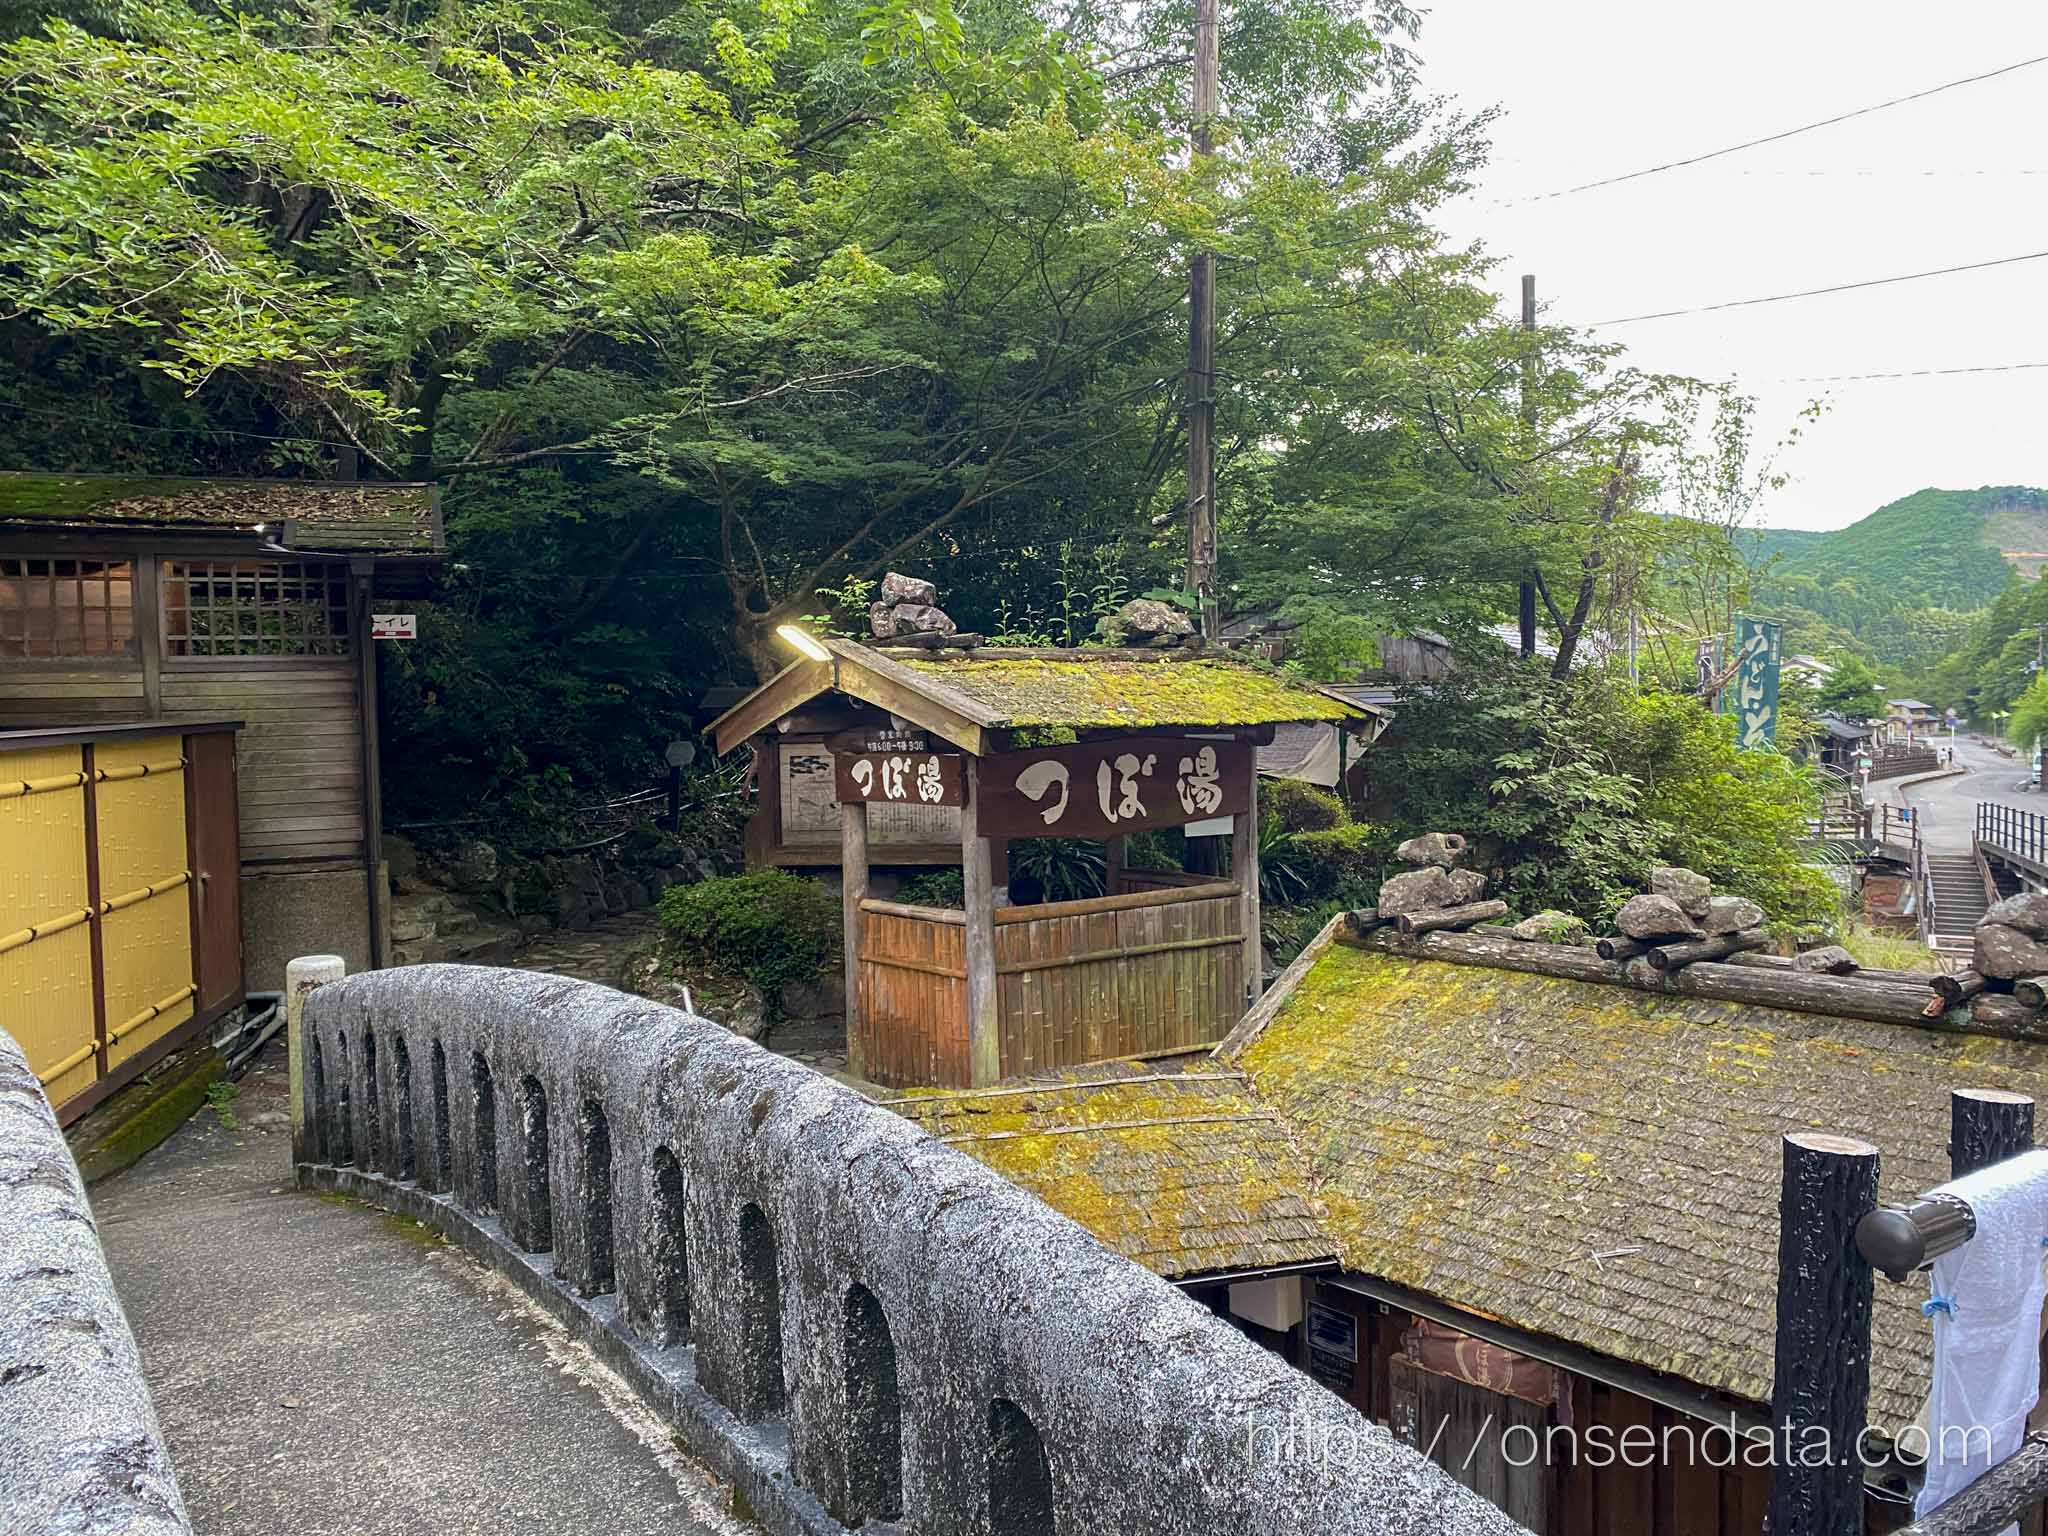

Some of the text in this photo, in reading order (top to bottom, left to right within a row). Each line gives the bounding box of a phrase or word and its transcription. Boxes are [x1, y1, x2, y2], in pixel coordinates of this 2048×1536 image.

[851, 756, 945, 803] つぼ湯
[1016, 745, 1223, 825] つぼ湯
